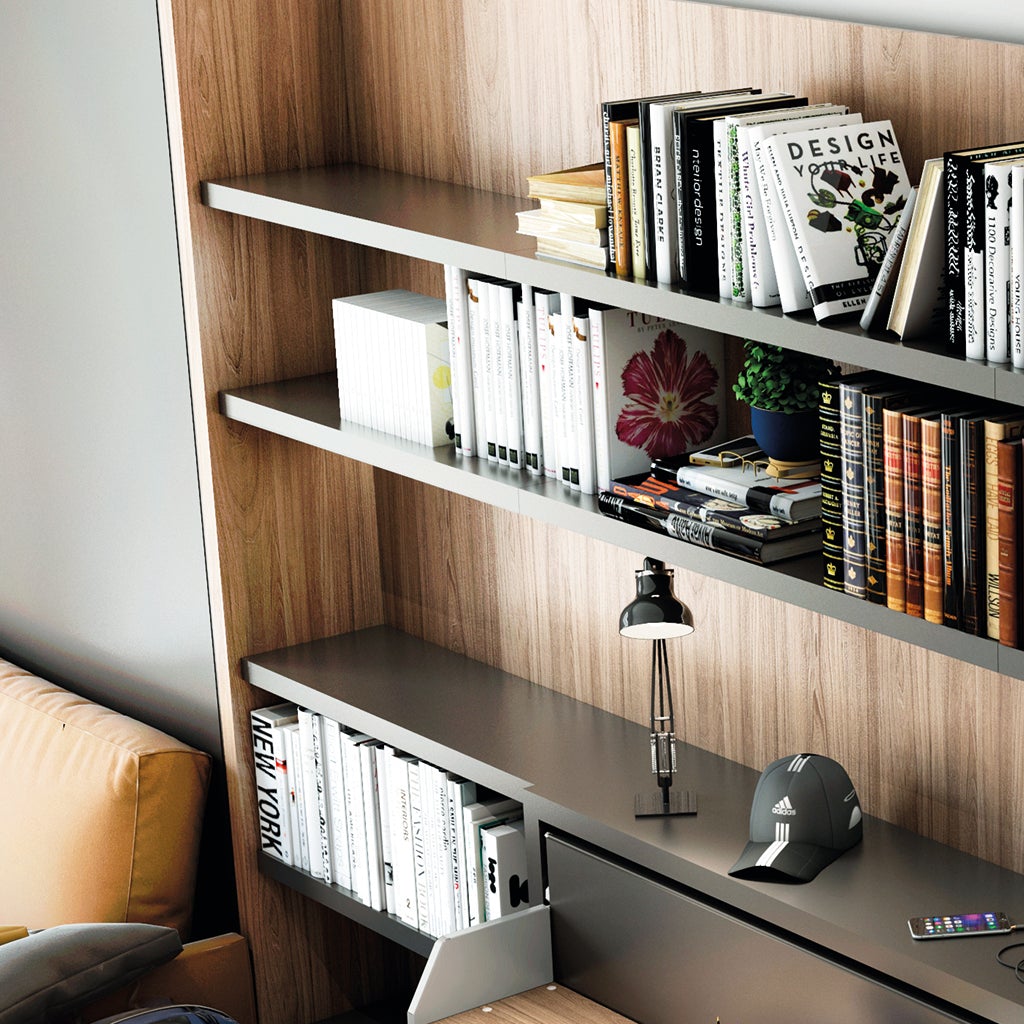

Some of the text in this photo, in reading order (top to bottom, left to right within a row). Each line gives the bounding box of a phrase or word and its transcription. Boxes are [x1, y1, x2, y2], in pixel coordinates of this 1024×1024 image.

[786, 128, 896, 161] DESIGN
[615, 155, 623, 203] MATTHEW
[792, 151, 901, 177] YOUR LIFE
[654, 146, 665, 243] BRIAN CLARKE
[745, 194, 754, 219] Girl
[988, 216, 996, 243] 1100
[747, 222, 758, 279] Problems
[987, 307, 998, 351] Designs
[592, 323, 601, 378] TULIPS
[985, 436, 997, 465] EGGS
[987, 484, 999, 509] HAVE
[988, 516, 999, 540] LAID
[988, 573, 1000, 619] WILLSON
[252, 716, 283, 858] NEW YORK
[400, 789, 409, 843] INTERIORS
[771, 807, 797, 816] adidas
[487, 857, 497, 894] logo
